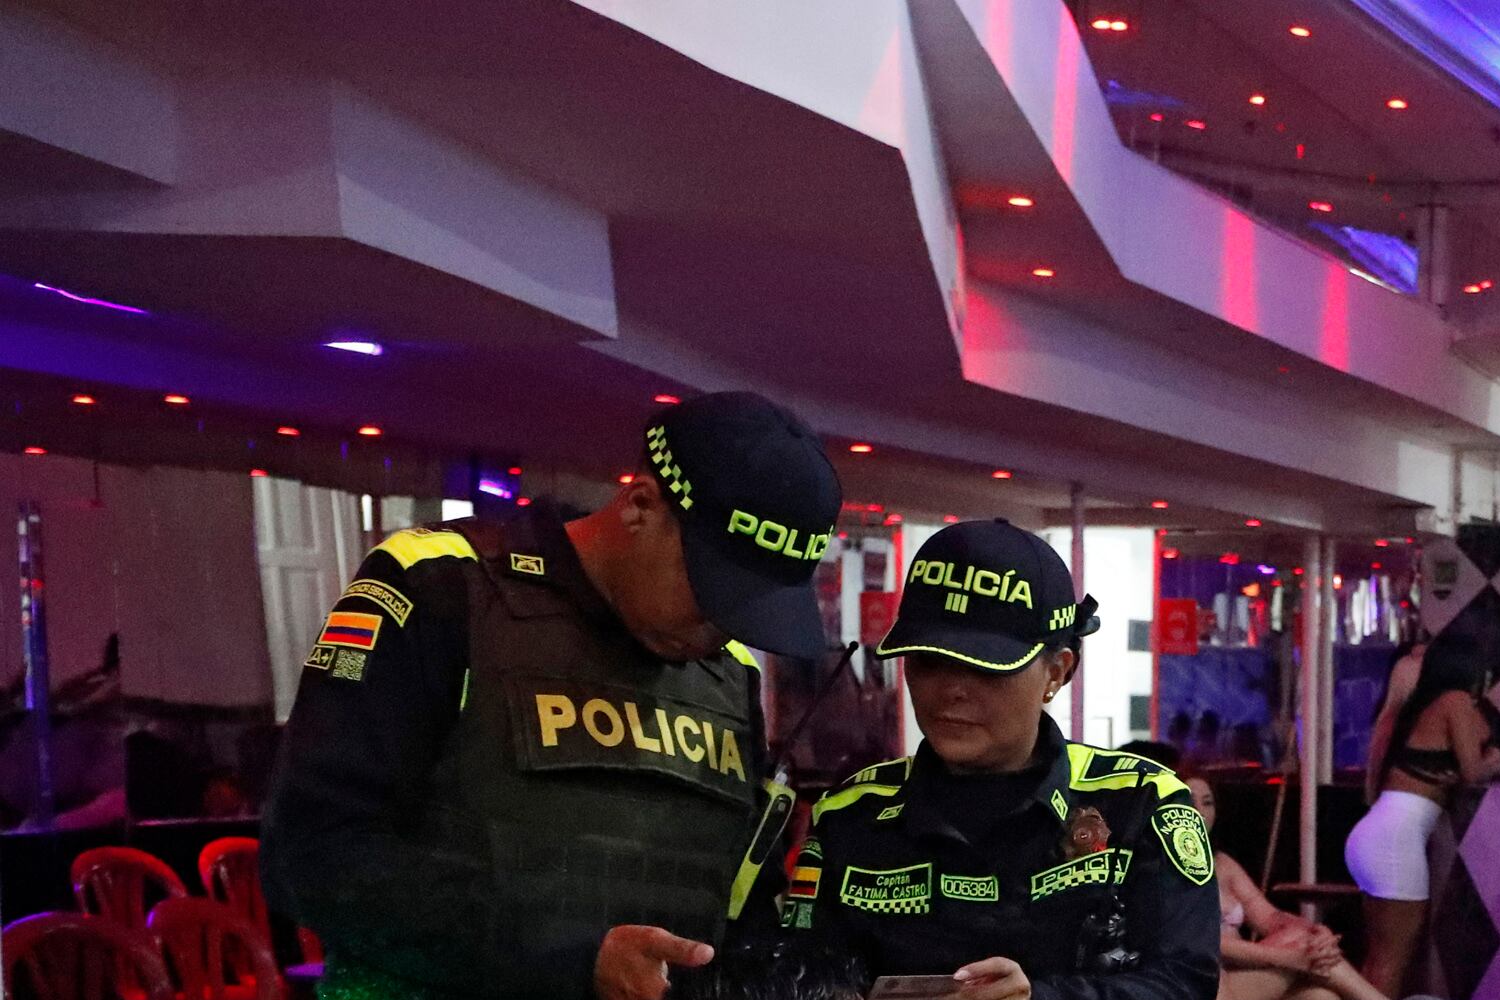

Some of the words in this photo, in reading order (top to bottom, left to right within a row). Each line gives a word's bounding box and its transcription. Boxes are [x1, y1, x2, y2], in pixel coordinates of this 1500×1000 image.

[728, 509, 834, 560] POLICÍ
[910, 560, 1033, 610] POLICÍA
[535, 694, 746, 782] POLICIA
[1160, 818, 1206, 842] NACIONAL
[848, 885, 888, 899] FATIMA
[892, 883, 927, 899] CASTRO
[944, 880, 995, 897] 005384
